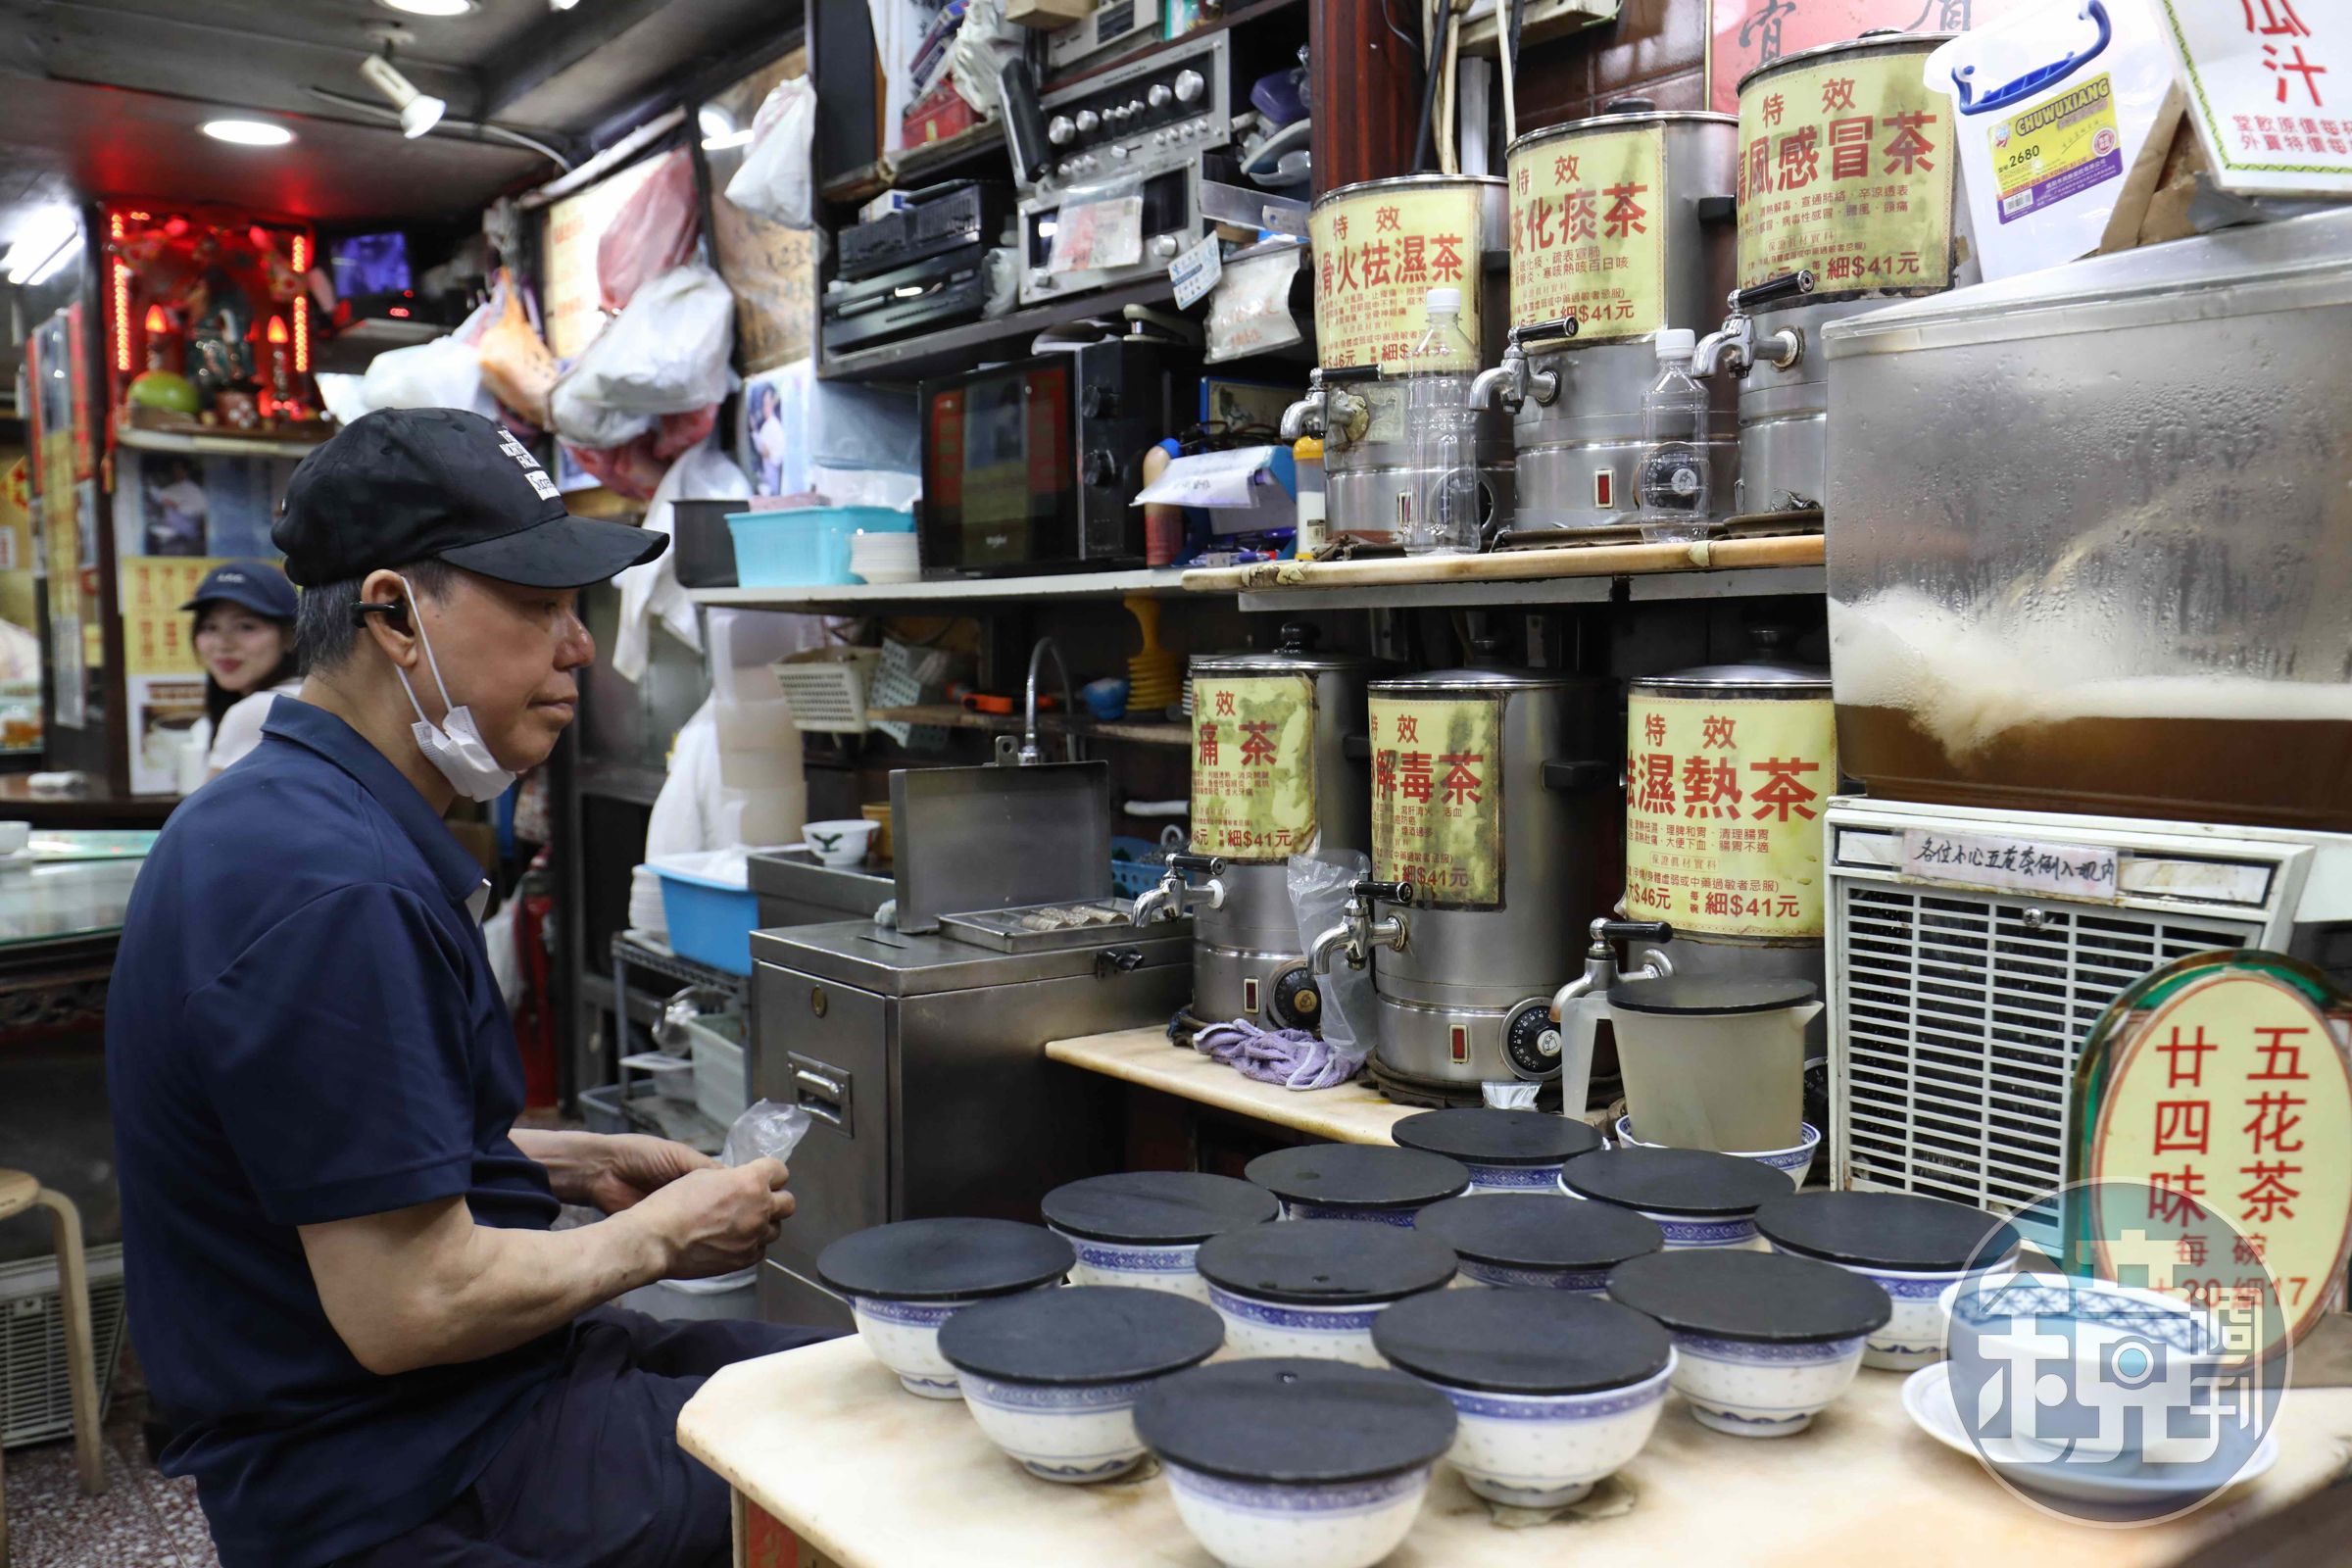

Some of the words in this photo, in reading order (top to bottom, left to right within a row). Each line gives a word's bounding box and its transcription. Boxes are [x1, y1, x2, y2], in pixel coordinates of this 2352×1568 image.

[1763, 76, 1856, 128] 特效
[2015, 77, 2111, 136] CHUWUXIANG
[2009, 144, 2040, 168] 2680
[2240, 133, 2352, 155] 外賣特價每
[1517, 154, 1581, 195] 特效
[1333, 206, 1401, 241] 特效
[1316, 233, 1463, 300] 骨火祛濕茶
[1827, 251, 1920, 278] 細$41元
[1645, 712, 1738, 750] 特效
[1371, 748, 1484, 806] 解毒茶
[1227, 829, 1293, 848] 細$41元
[1704, 892, 1800, 918] 細$41元
[2146, 1025, 2218, 1228] 廿四味
[2238, 1025, 2311, 1224] 五花茶
